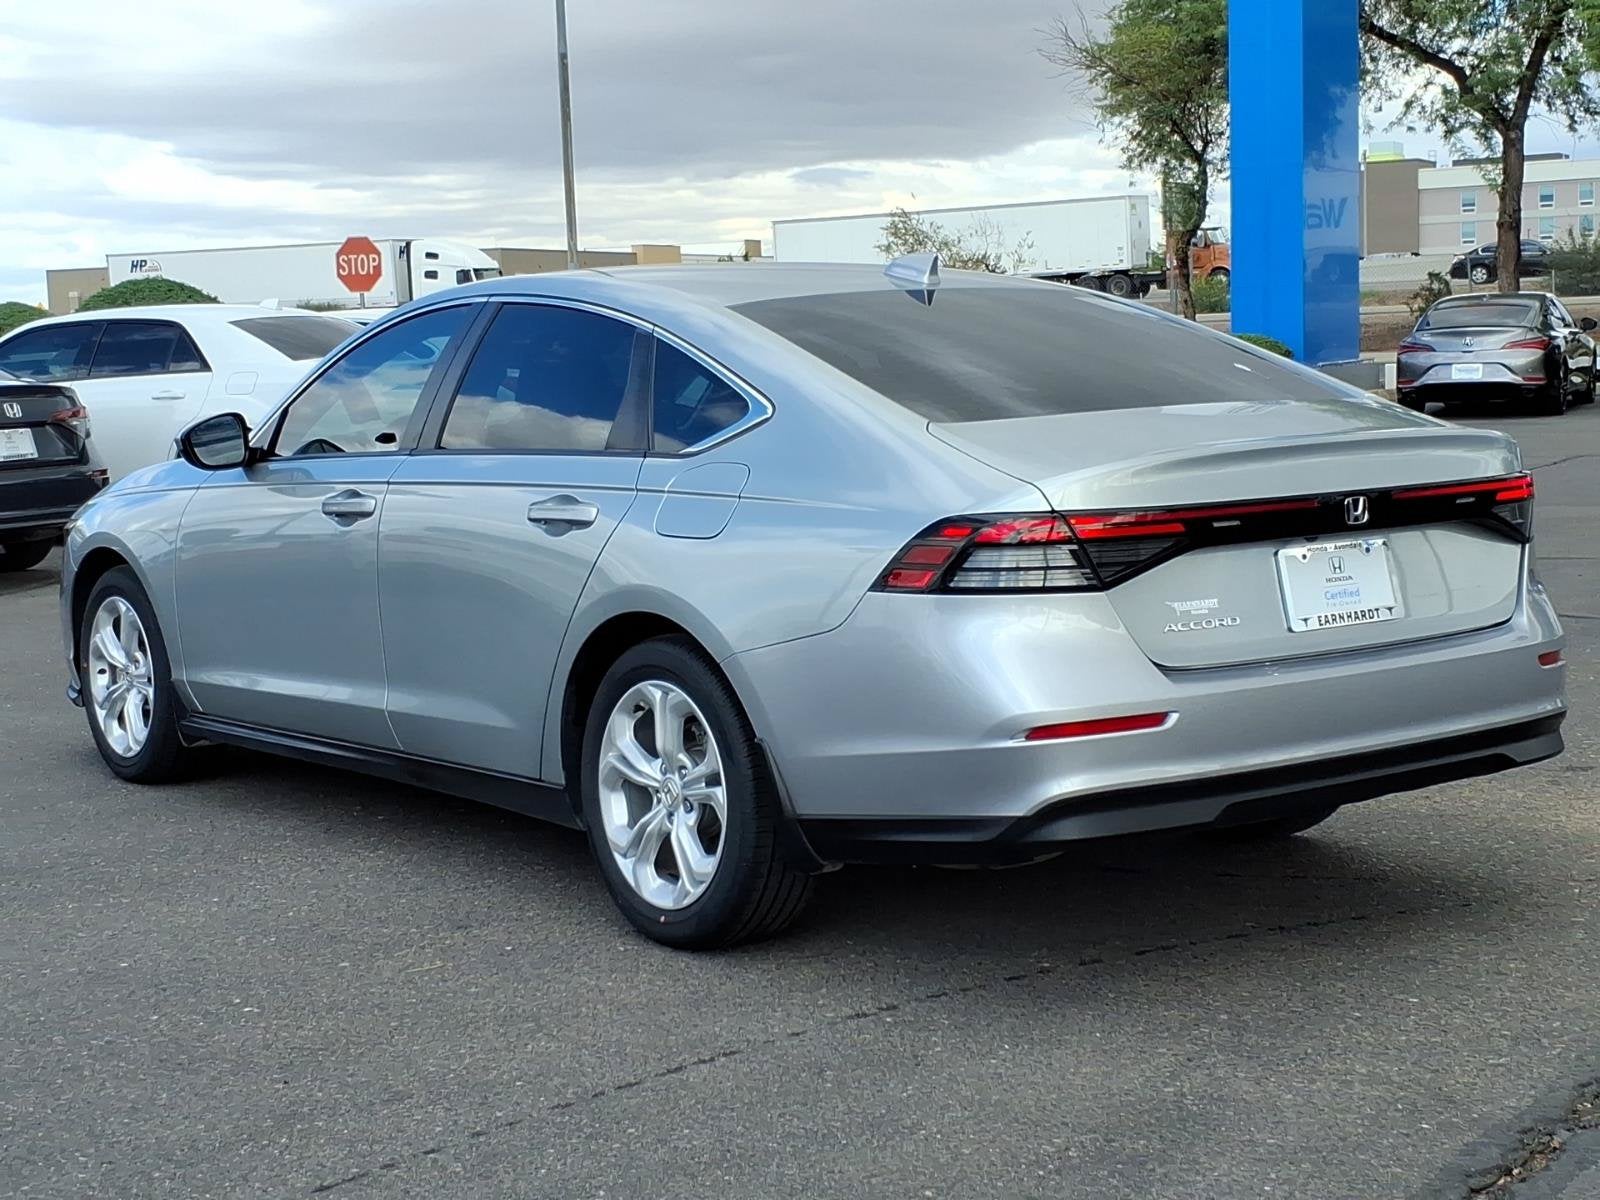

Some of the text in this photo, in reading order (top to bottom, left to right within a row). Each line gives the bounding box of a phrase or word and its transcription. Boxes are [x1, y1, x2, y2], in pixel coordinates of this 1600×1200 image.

[130, 259, 148, 274] HP
[338, 254, 379, 276] STOP
[1325, 575, 1353, 583] HONDA
[1324, 588, 1360, 601] Certified
[1163, 616, 1241, 634] ACCORD
[1317, 608, 1381, 627] EARNHARDT
